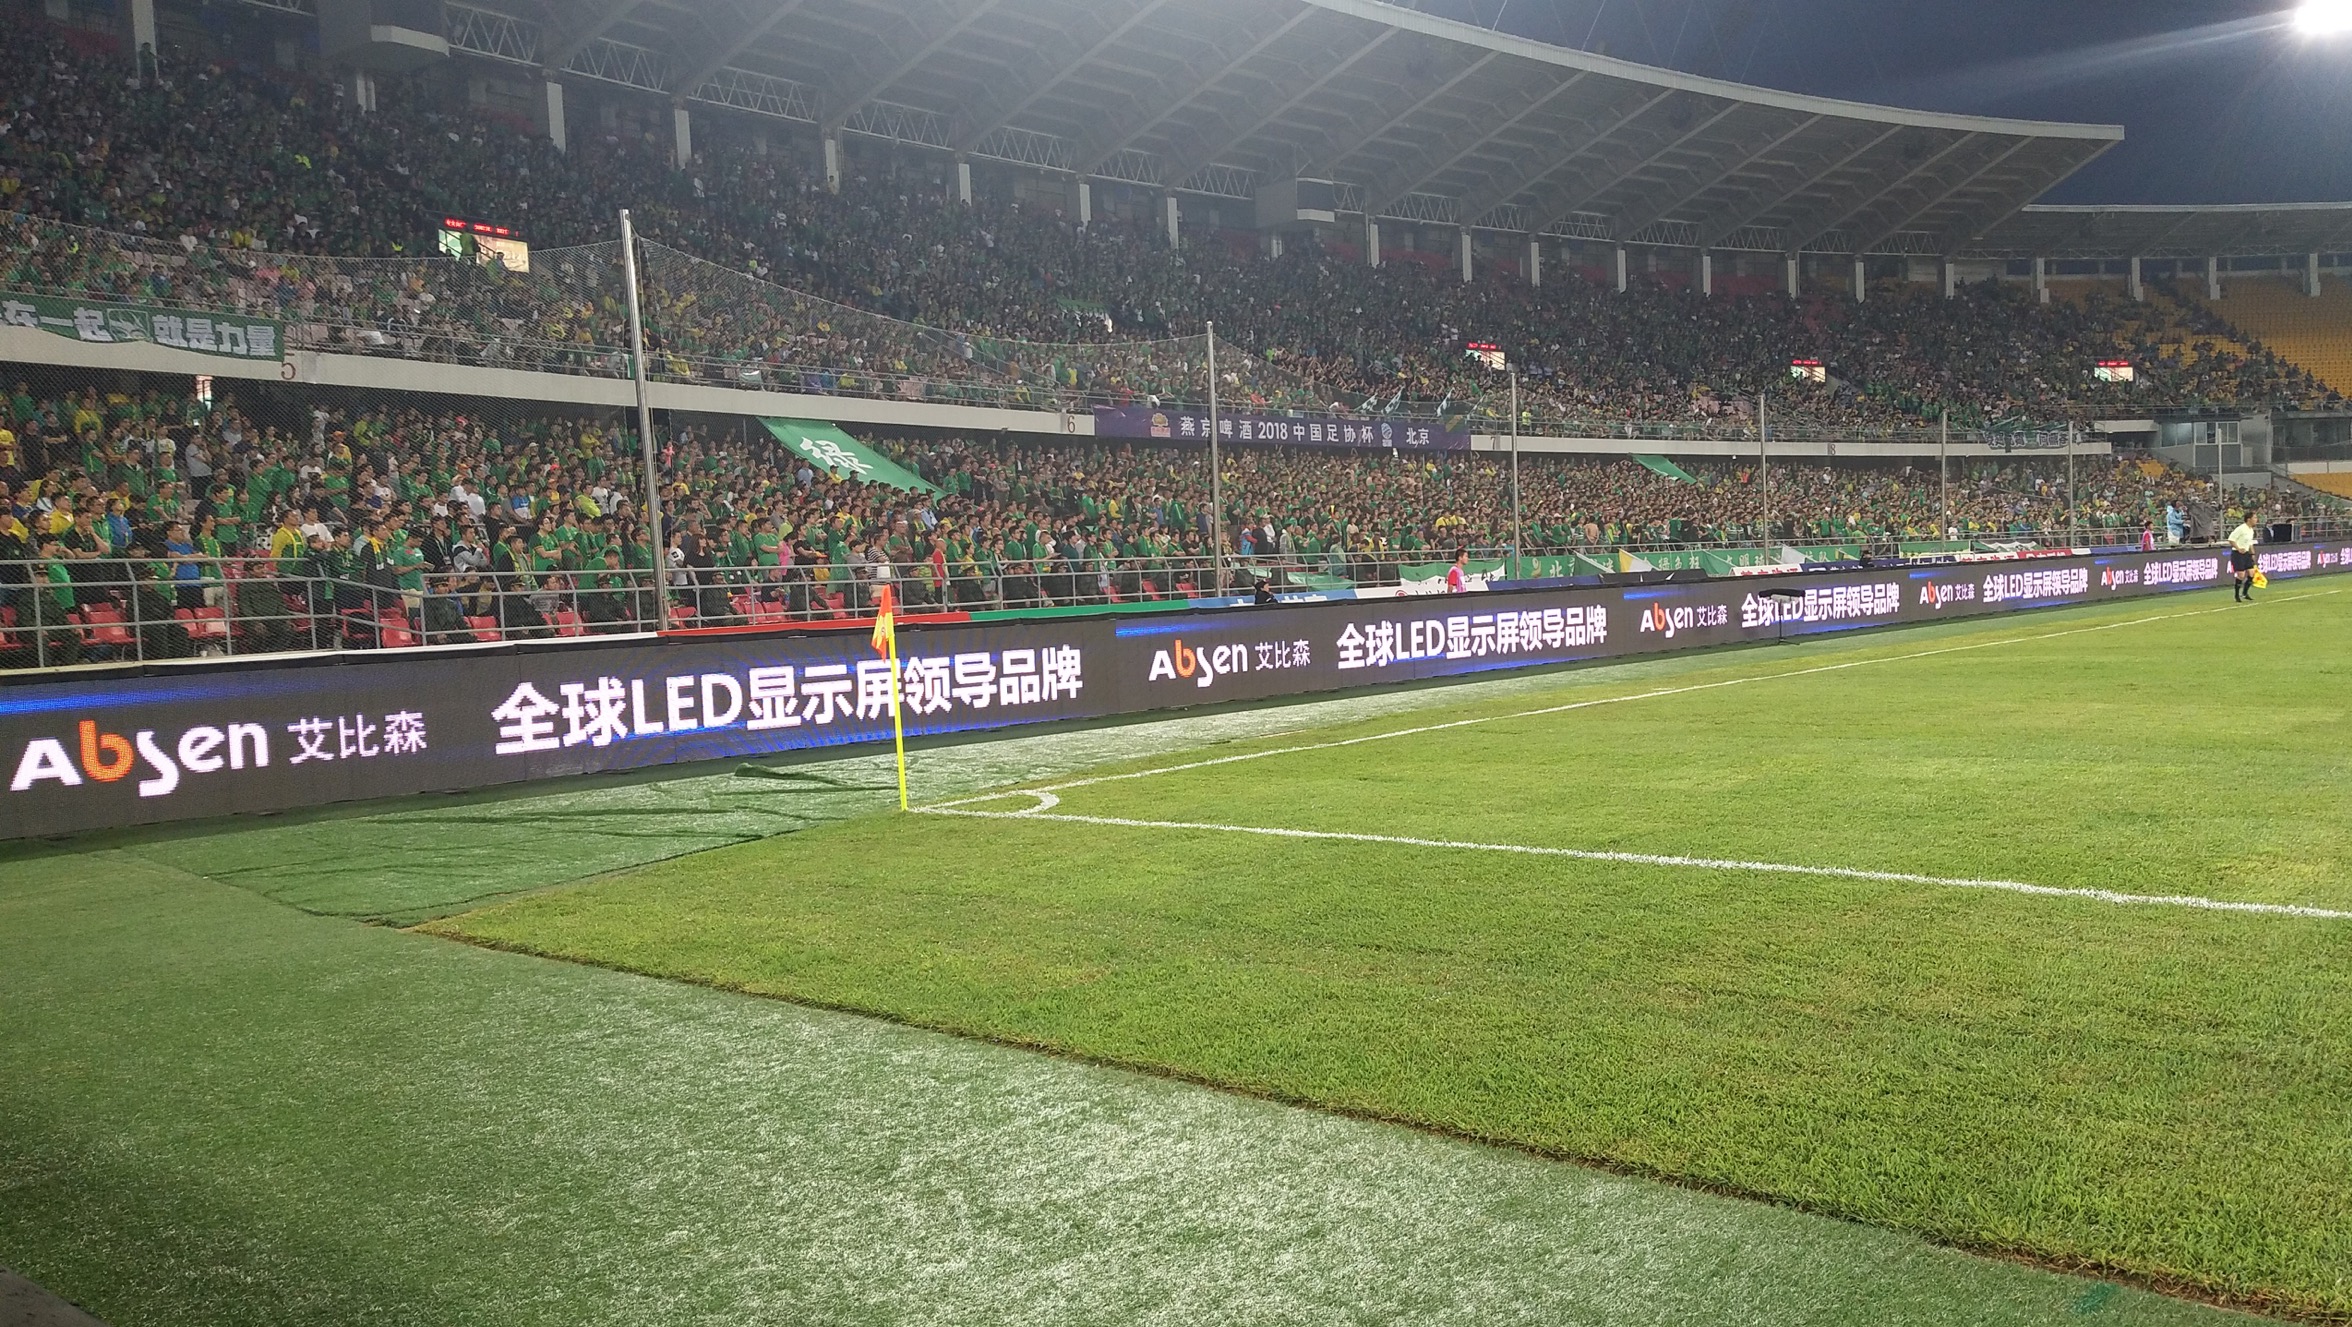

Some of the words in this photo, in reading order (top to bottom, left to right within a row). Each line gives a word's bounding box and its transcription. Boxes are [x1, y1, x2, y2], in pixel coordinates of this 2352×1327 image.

[0, 300, 113, 342] 在一起
[151, 314, 277, 357] 就是力量
[280, 352, 297, 381] 5
[1066, 415, 1076, 434] 6
[1406, 427, 1430, 446] 北京
[1982, 567, 2089, 603] 全球LED显示屏领导品牌
[2100, 566, 2125, 591] Absen
[2143, 557, 2219, 586] 全球LED显示屏领导品牌
[1918, 580, 1954, 610] Absen
[1954, 583, 1976, 601] 艾比森
[1336, 604, 1609, 670] 全球LED显示屏领导品牌
[1639, 601, 1694, 639] Absen
[1696, 604, 1728, 628] 艾比森
[1148, 638, 1249, 688] Absen
[1254, 638, 1311, 671] 艾比森
[491, 643, 1084, 757] 全球LED显示屏领导品牌
[10, 719, 270, 798] Absen
[287, 710, 427, 764] 艾比森
